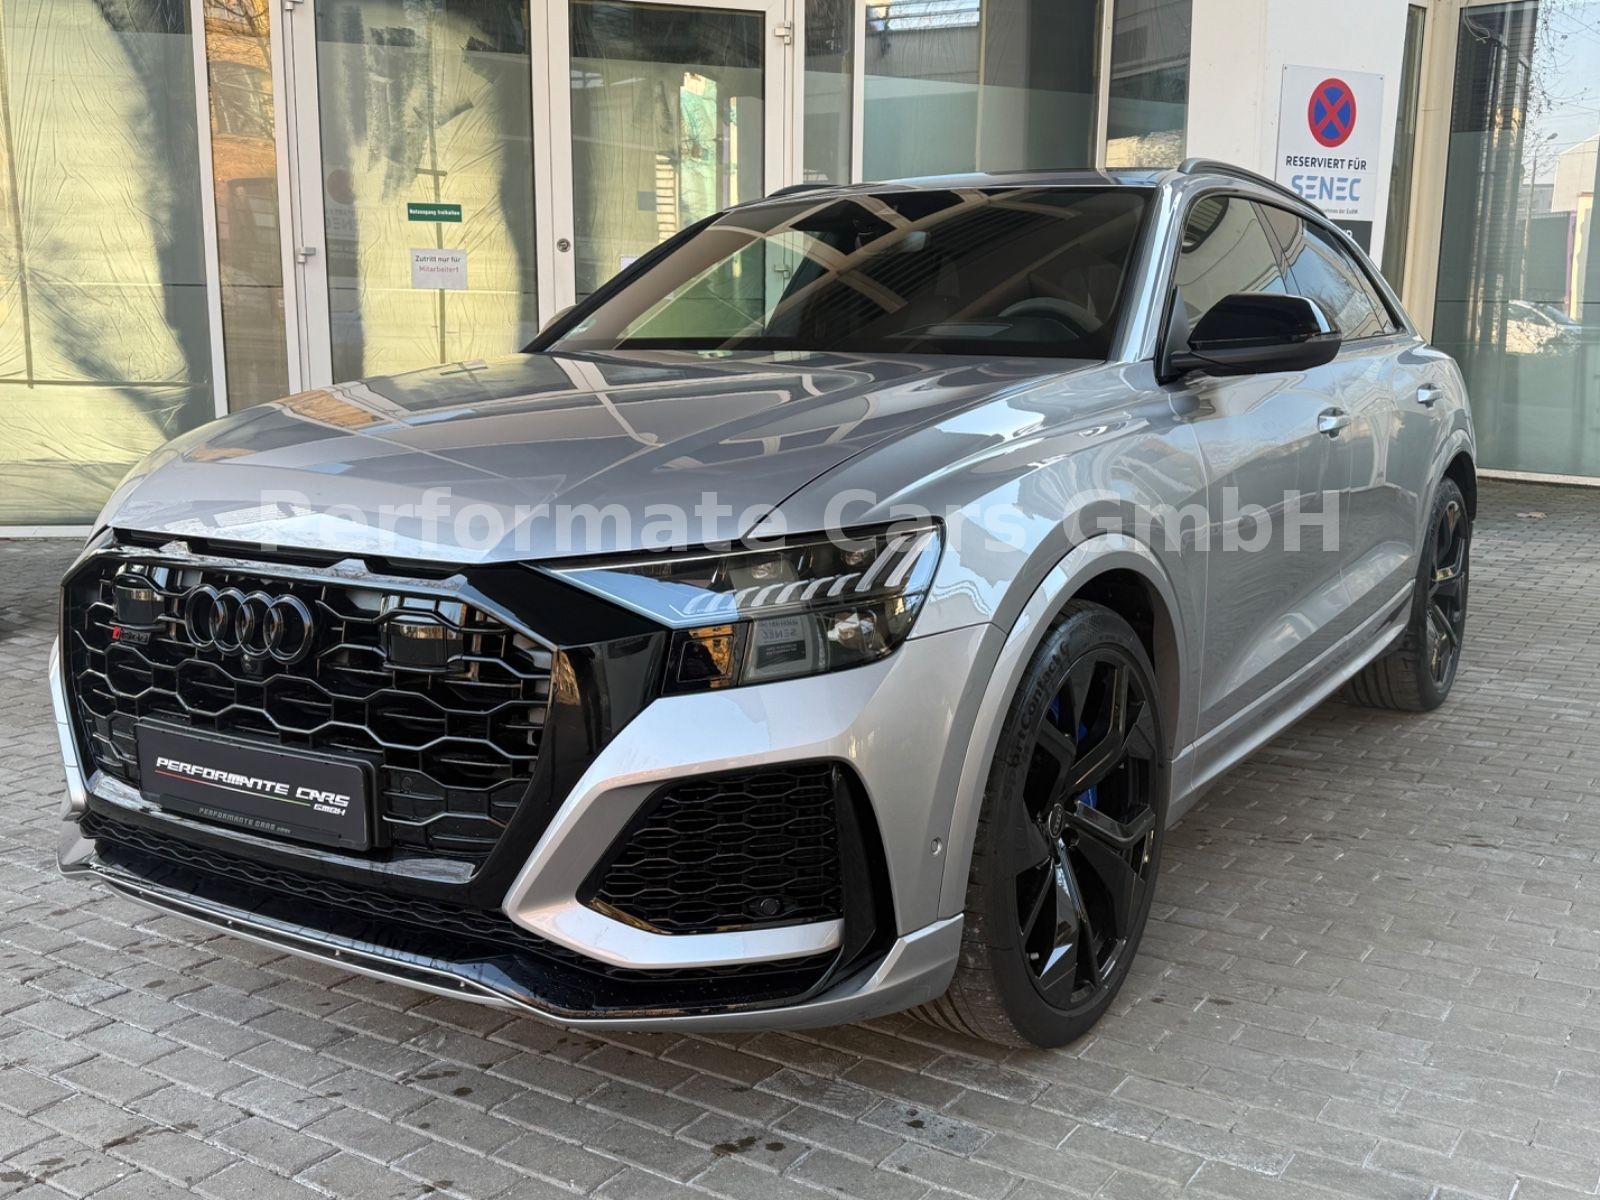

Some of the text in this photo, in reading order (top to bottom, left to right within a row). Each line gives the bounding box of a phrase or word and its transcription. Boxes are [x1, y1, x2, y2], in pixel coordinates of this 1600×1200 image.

[1286, 155, 1367, 171] RESERVIERT FÜR
[1291, 174, 1362, 202] SENEC
[415, 254, 437, 263] Zutritt
[451, 255, 461, 263] für
[156, 756, 351, 808] PERFORMANTE CARS
[199, 807, 254, 826] PERFORMANTE
